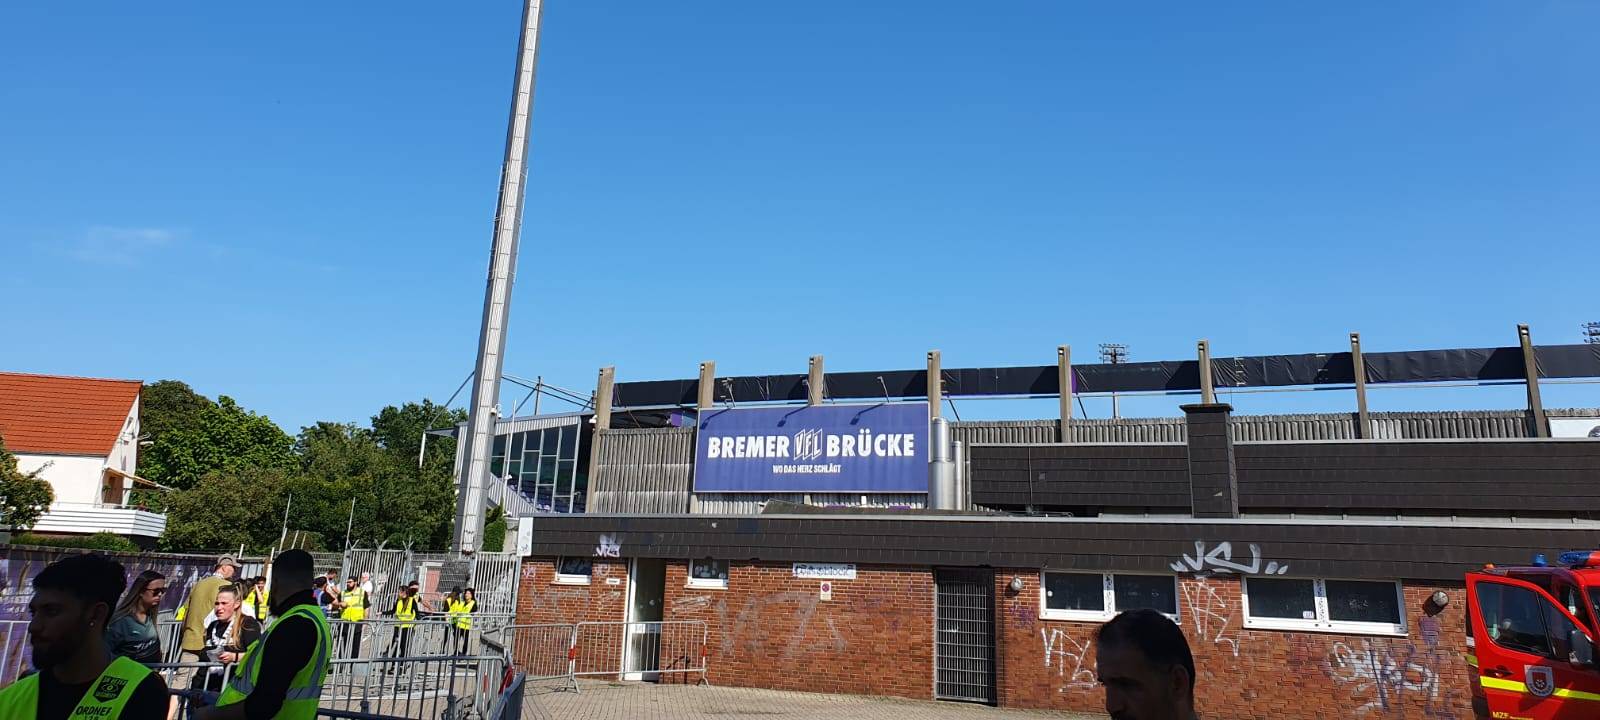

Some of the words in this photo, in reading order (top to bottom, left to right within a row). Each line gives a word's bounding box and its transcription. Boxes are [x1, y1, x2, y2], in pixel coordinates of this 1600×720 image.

[708, 436, 790, 458] BREMER
[826, 428, 914, 457] BRÜCKE
[772, 464, 783, 473] WO
[783, 464, 797, 473] DAS
[797, 464, 813, 473] HERZ
[813, 462, 842, 473] SCHLÄGT
